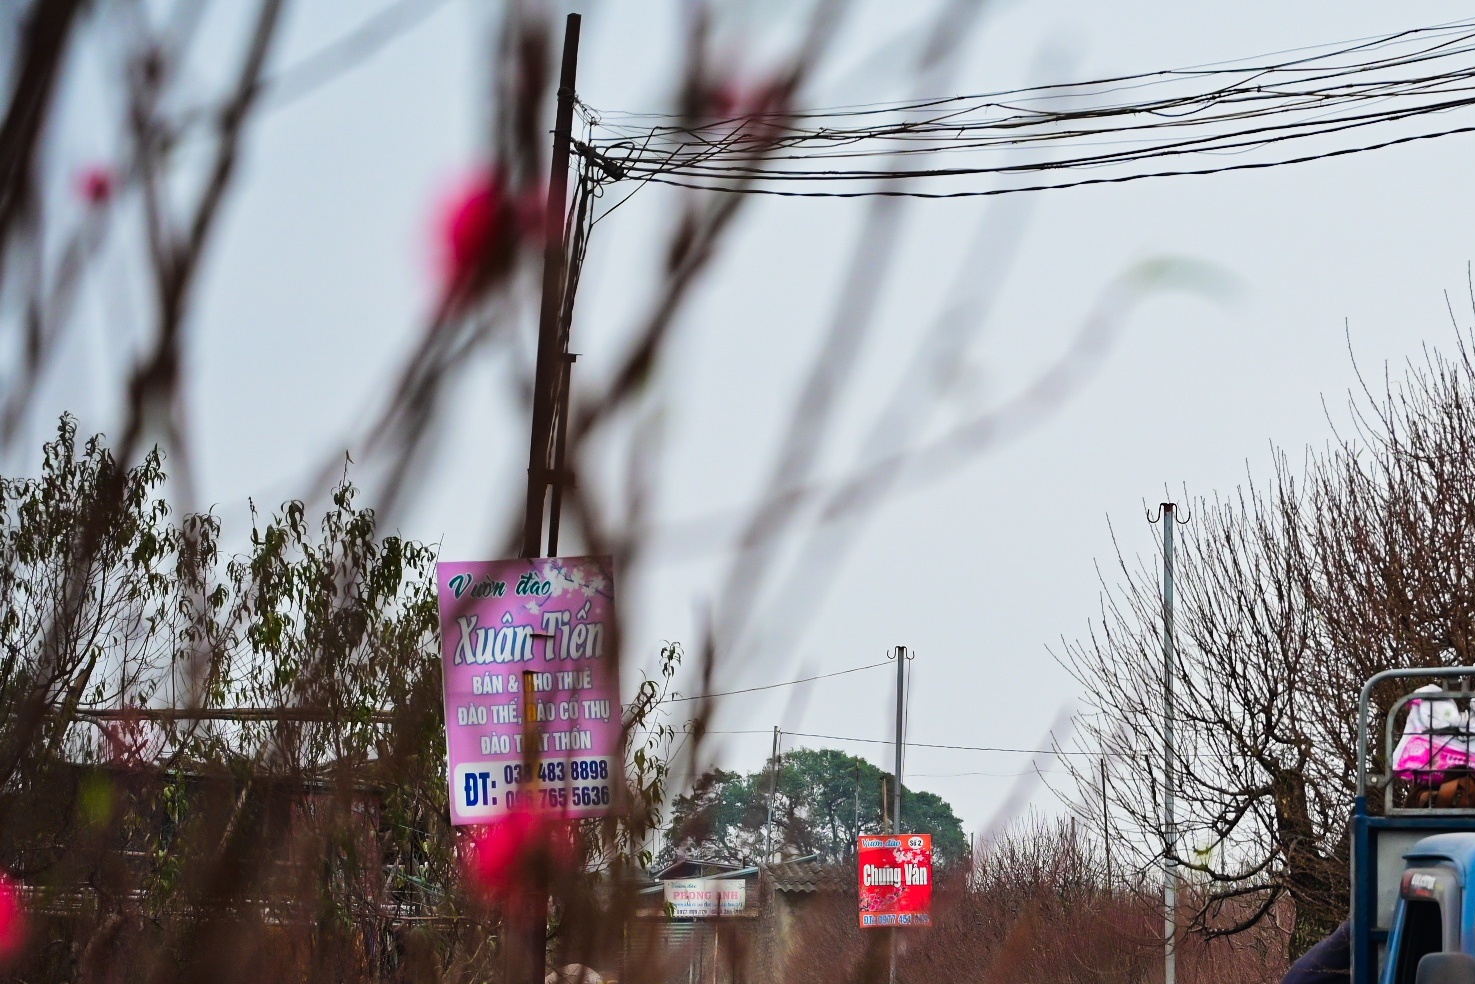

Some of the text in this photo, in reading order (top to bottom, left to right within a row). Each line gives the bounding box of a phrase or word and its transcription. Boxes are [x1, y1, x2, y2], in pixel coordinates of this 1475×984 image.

[449, 572, 551, 599] Vườn đào
[454, 601, 605, 666] Xuân Tiến
[472, 671, 503, 695] BÁN
[507, 673, 519, 693] &
[458, 701, 487, 726] ĐÀO
[582, 700, 610, 724] THỤ
[480, 724, 592, 755] ĐÀO TT THỐN
[537, 762, 566, 783] 483
[570, 759, 609, 782] 8898
[464, 771, 498, 808] ĐT:
[538, 786, 567, 809] 765
[571, 785, 611, 807] 5636
[863, 863, 928, 888] Chung Vân
[672, 891, 712, 900] PHONG
